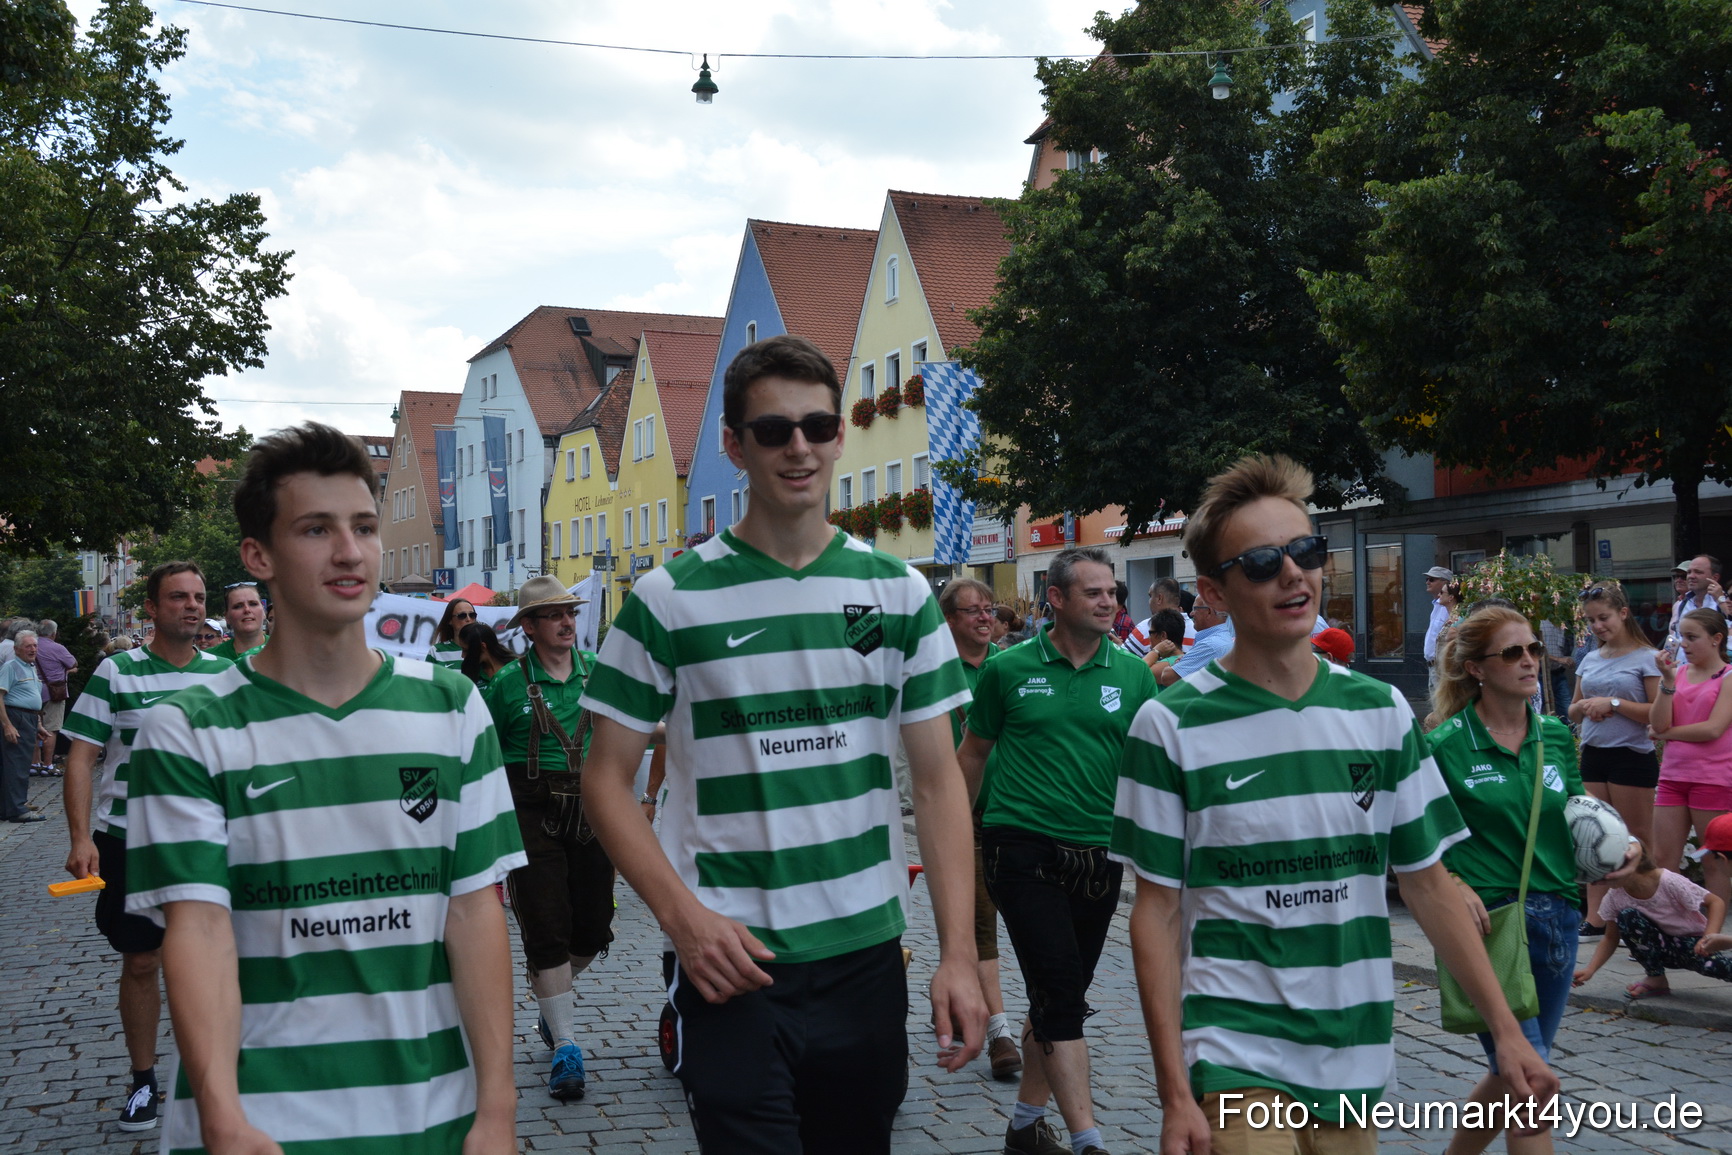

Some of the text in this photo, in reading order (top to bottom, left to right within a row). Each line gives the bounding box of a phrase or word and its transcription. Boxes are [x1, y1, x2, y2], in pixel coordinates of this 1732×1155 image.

[440, 471, 455, 507] K&L
[574, 493, 613, 513] HOTEL Lehmeier
[988, 533, 998, 544] KINO
[635, 557, 650, 568] AIFUN
[847, 606, 863, 617] SV
[860, 633, 879, 650] 1950
[721, 696, 876, 729] Schornsteintechnik
[759, 730, 848, 756] Neumarkt
[403, 770, 420, 782] SV
[1352, 766, 1364, 776] SV
[1471, 764, 1493, 773] JAKO
[416, 798, 434, 815] 1950
[1218, 845, 1379, 880] Schornsteintechnik
[1266, 882, 1348, 909] Neumarkt
[290, 907, 411, 939] Neumarkt
